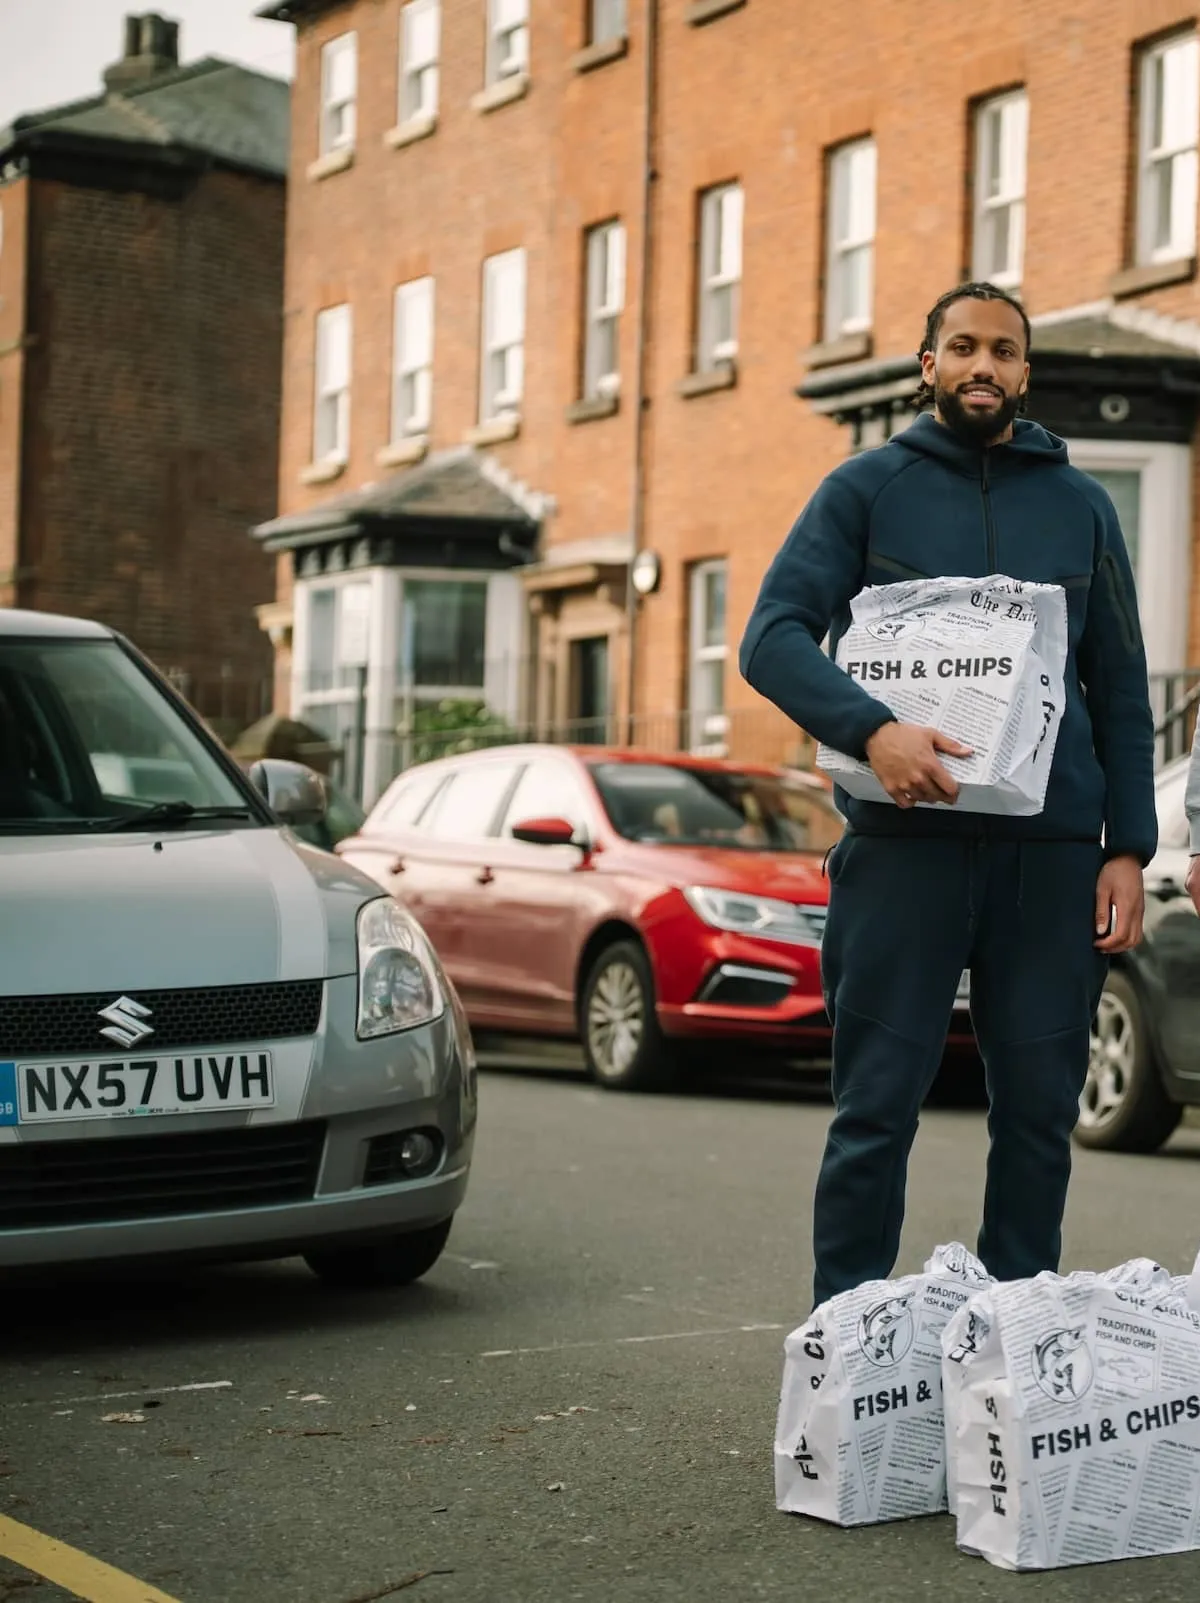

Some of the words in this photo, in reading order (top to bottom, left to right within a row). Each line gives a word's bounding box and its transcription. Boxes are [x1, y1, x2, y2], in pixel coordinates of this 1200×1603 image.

[846, 660, 902, 680] FISH
[910, 659, 928, 679] &
[937, 656, 1013, 678] CHIPS
[26, 1060, 159, 1113] NX57
[174, 1054, 270, 1102] UVH
[1095, 1330, 1114, 1339] FISH
[1114, 1333, 1132, 1345] AND
[1132, 1338, 1157, 1352] CHIPS
[1096, 1316, 1158, 1339] TRADITIONAL
[853, 1385, 909, 1422] FISH
[915, 1379, 933, 1403] &
[1030, 1423, 1093, 1460] FISH
[1099, 1418, 1119, 1443] &
[987, 1432, 1008, 1517] FISH
